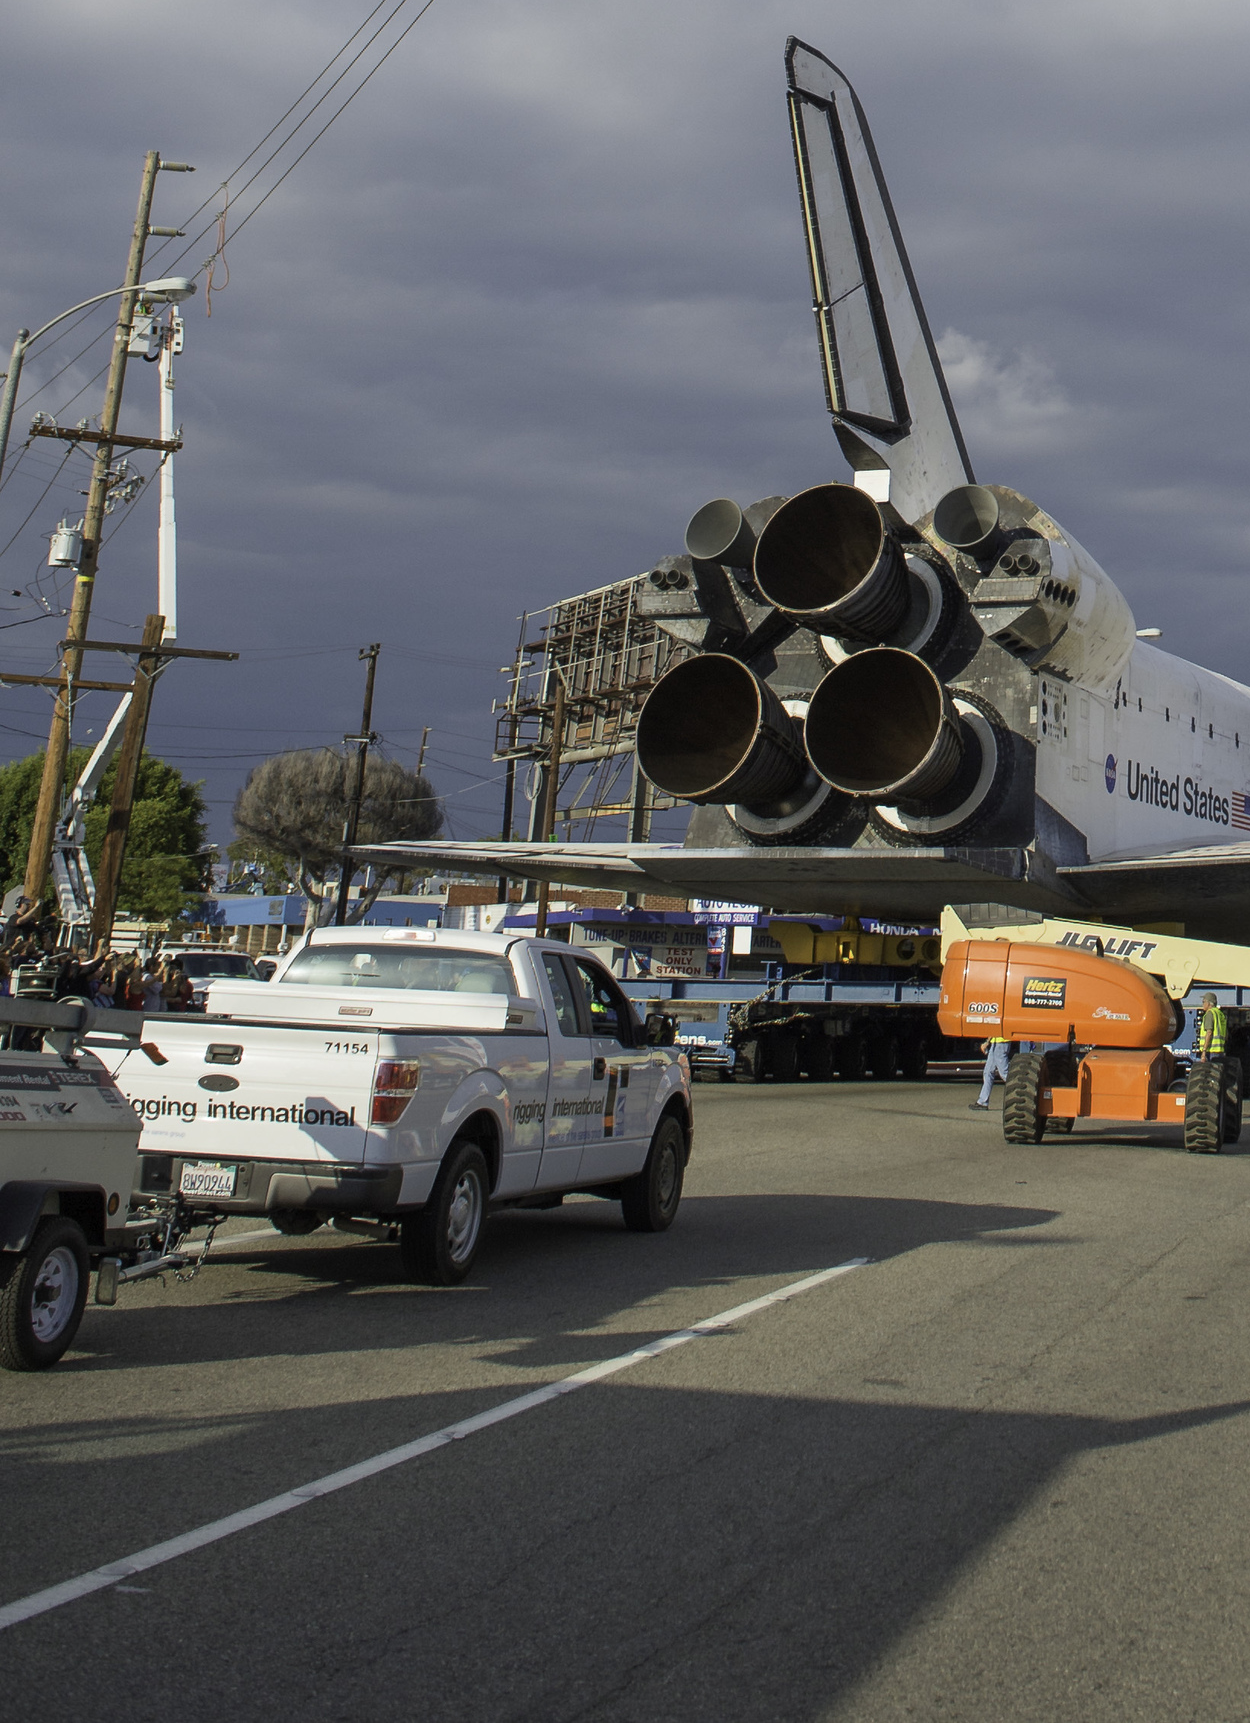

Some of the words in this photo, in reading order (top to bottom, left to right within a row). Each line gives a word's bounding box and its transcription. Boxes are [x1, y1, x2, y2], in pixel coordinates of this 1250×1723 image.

[1127, 759, 1180, 812] United
[1183, 777, 1230, 826] States
[694, 913, 717, 924] COMPLETE
[718, 913, 732, 923] AUTO
[732, 913, 755, 923] SERVICE
[870, 922, 919, 936] HONDA
[629, 929, 668, 944] BRAKES
[666, 947, 696, 956] TEST
[1055, 931, 1101, 951] JLG
[1104, 936, 1157, 959] LIFT
[665, 956, 693, 965] ONLY
[656, 965, 701, 975] STATION
[1026, 979, 1064, 992] Hertz
[968, 1002, 999, 1015] 600S
[324, 1041, 369, 1055] 71154
[56, 1072, 97, 1084] TEREX
[126, 1094, 198, 1122] igging
[207, 1098, 356, 1127] international
[513, 1098, 547, 1125] rigging
[552, 1095, 605, 1117] international
